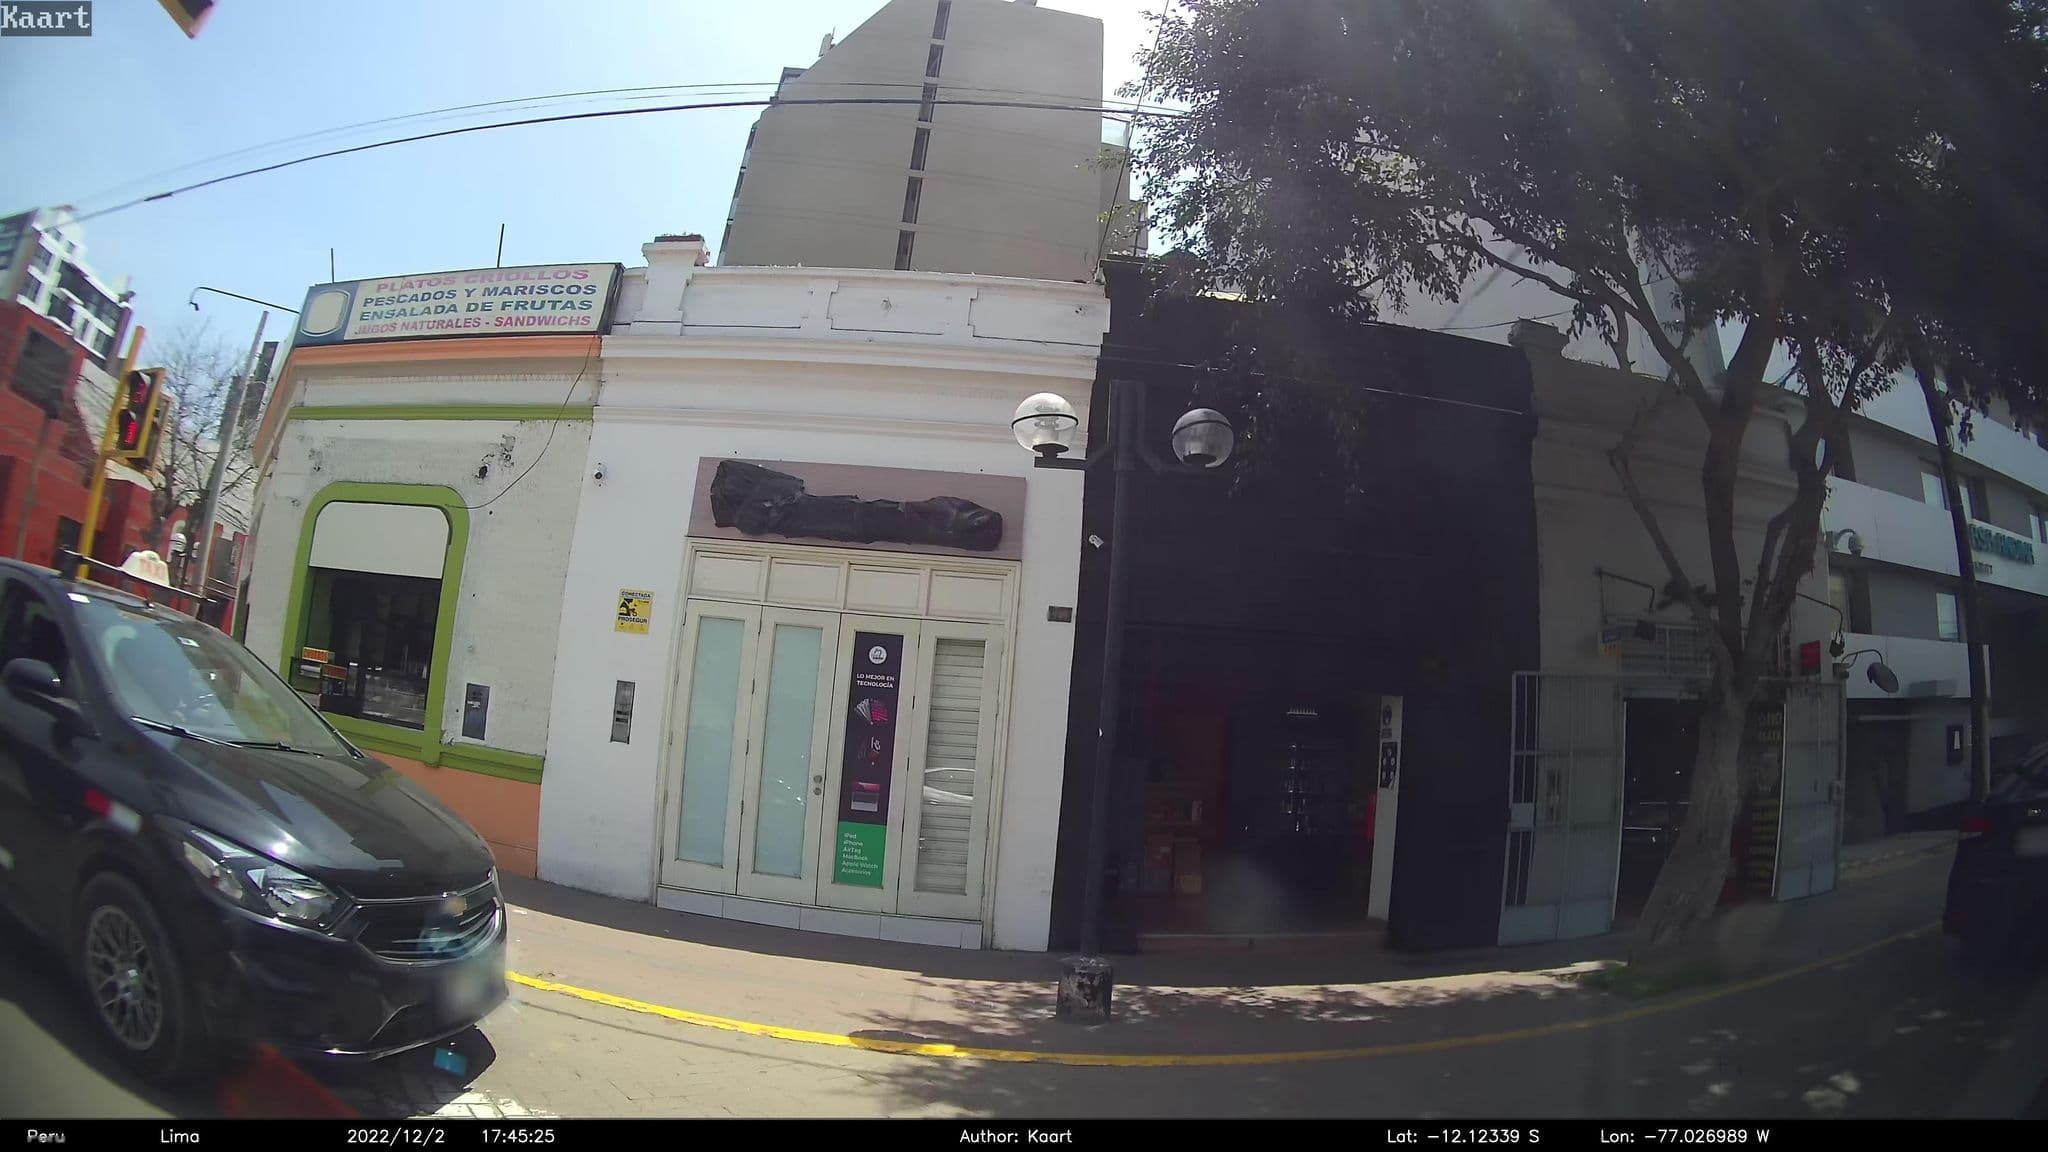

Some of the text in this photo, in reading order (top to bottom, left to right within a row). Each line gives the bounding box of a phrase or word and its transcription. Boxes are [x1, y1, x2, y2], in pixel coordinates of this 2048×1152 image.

[376, 269, 590, 293] PLATOS CRIOLLOS
[363, 284, 598, 308] PESCADOS Y MARISCOS
[360, 300, 593, 321] ENSALADA DE FRUTAS
[354, 322, 397, 335] JUGOS
[400, 316, 482, 331] NATURALES
[494, 315, 592, 328] SANDWICHS
[617, 616, 649, 624] PROSEGUR
[856, 680, 894, 689] TECNOLOGÍA
